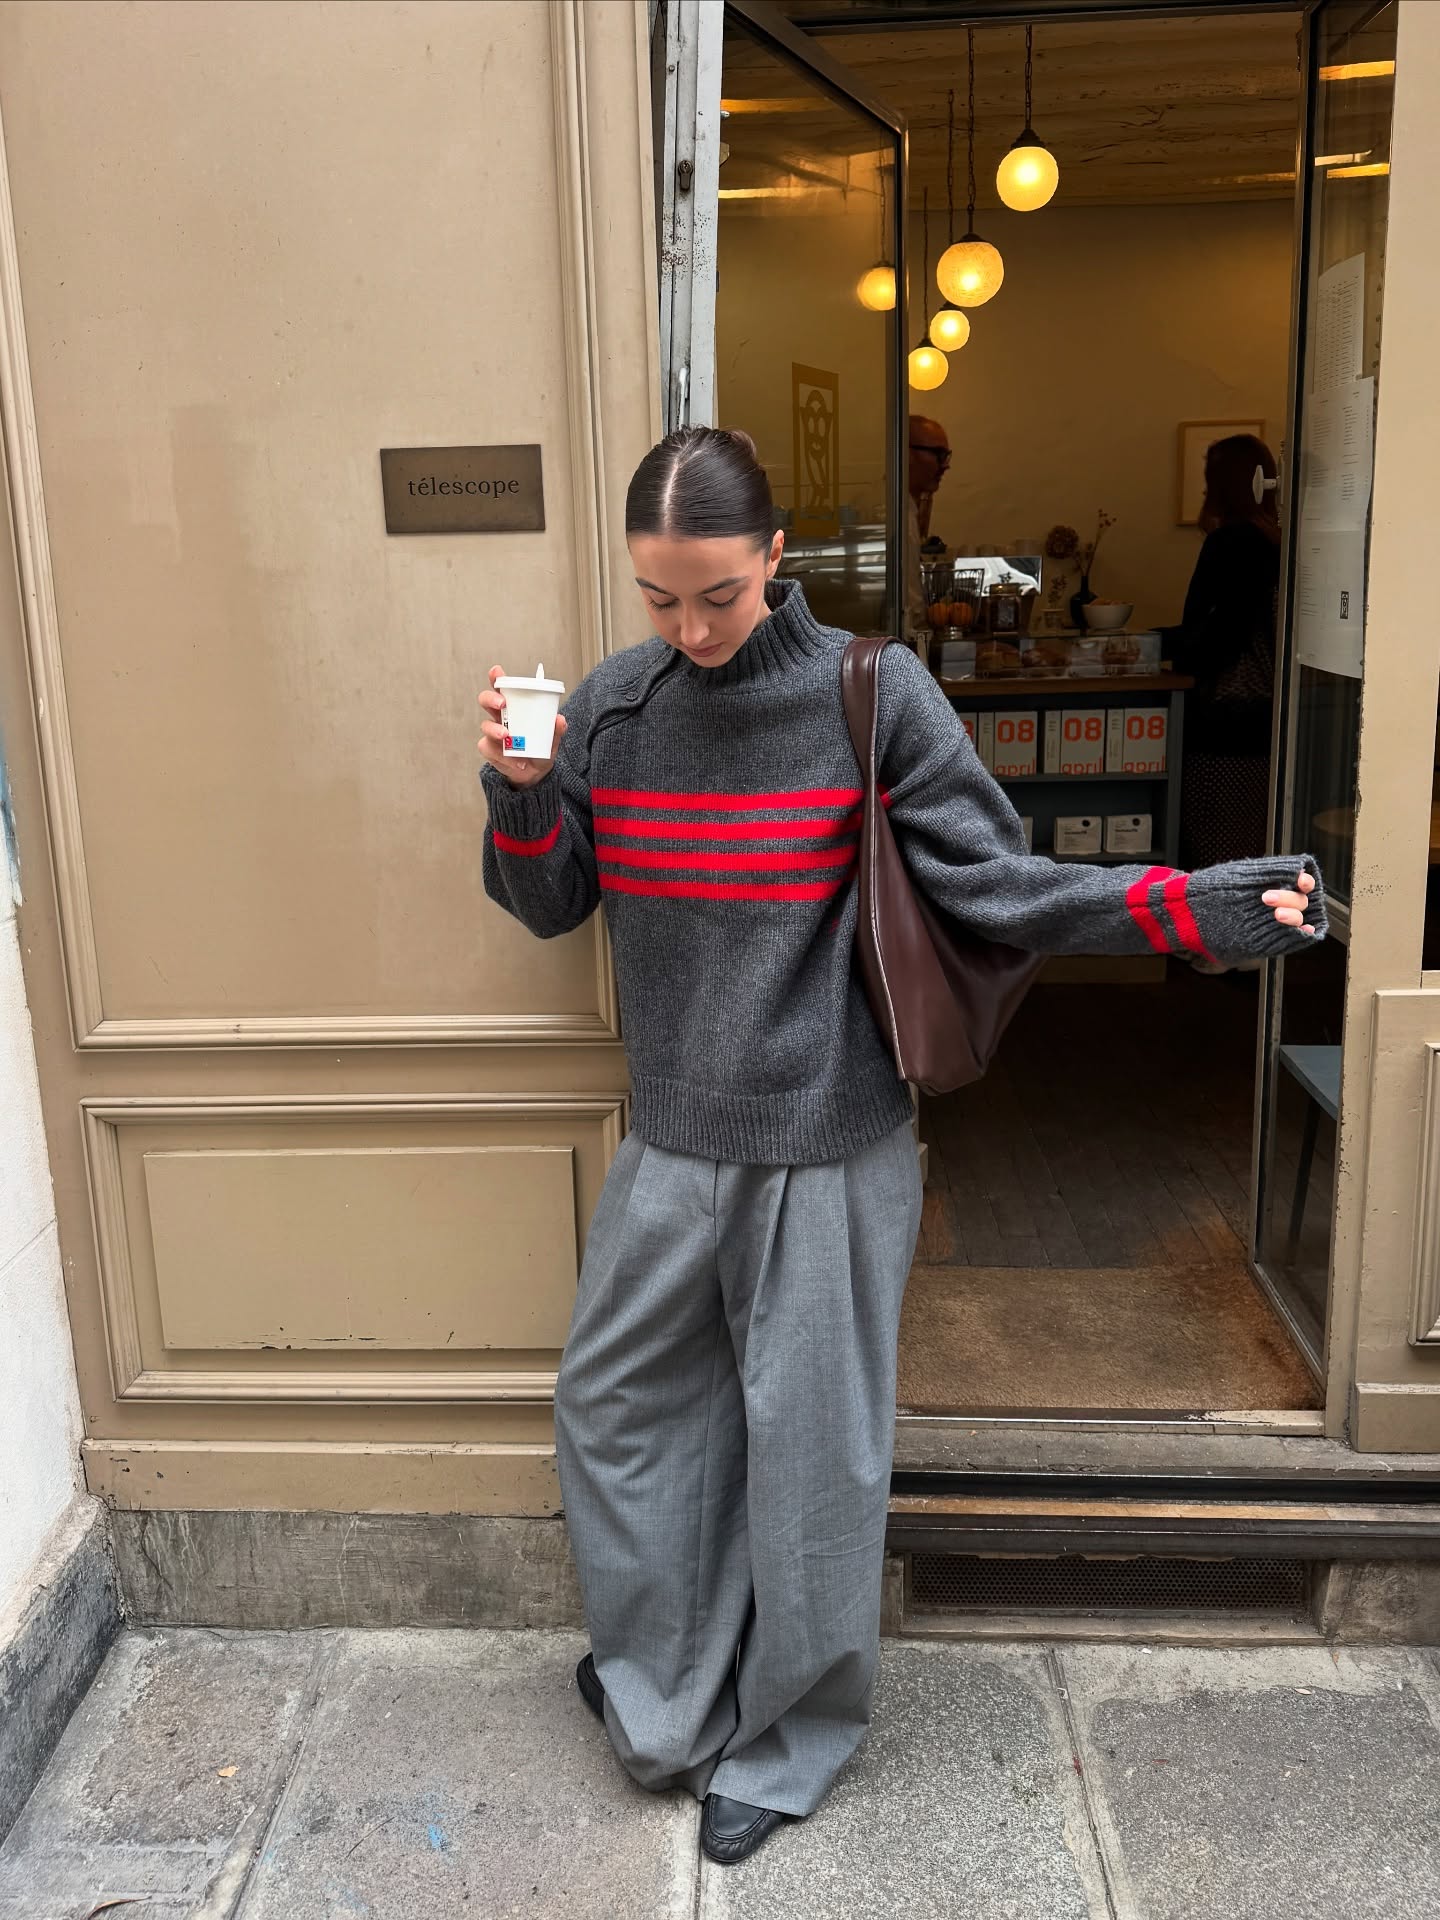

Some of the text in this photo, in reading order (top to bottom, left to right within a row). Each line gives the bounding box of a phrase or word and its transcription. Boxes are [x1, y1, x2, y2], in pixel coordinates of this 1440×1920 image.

[408, 477, 519, 498] télescope
[997, 719, 1034, 743] 08
[1064, 717, 1102, 742] 08
[1126, 715, 1165, 740] 08
